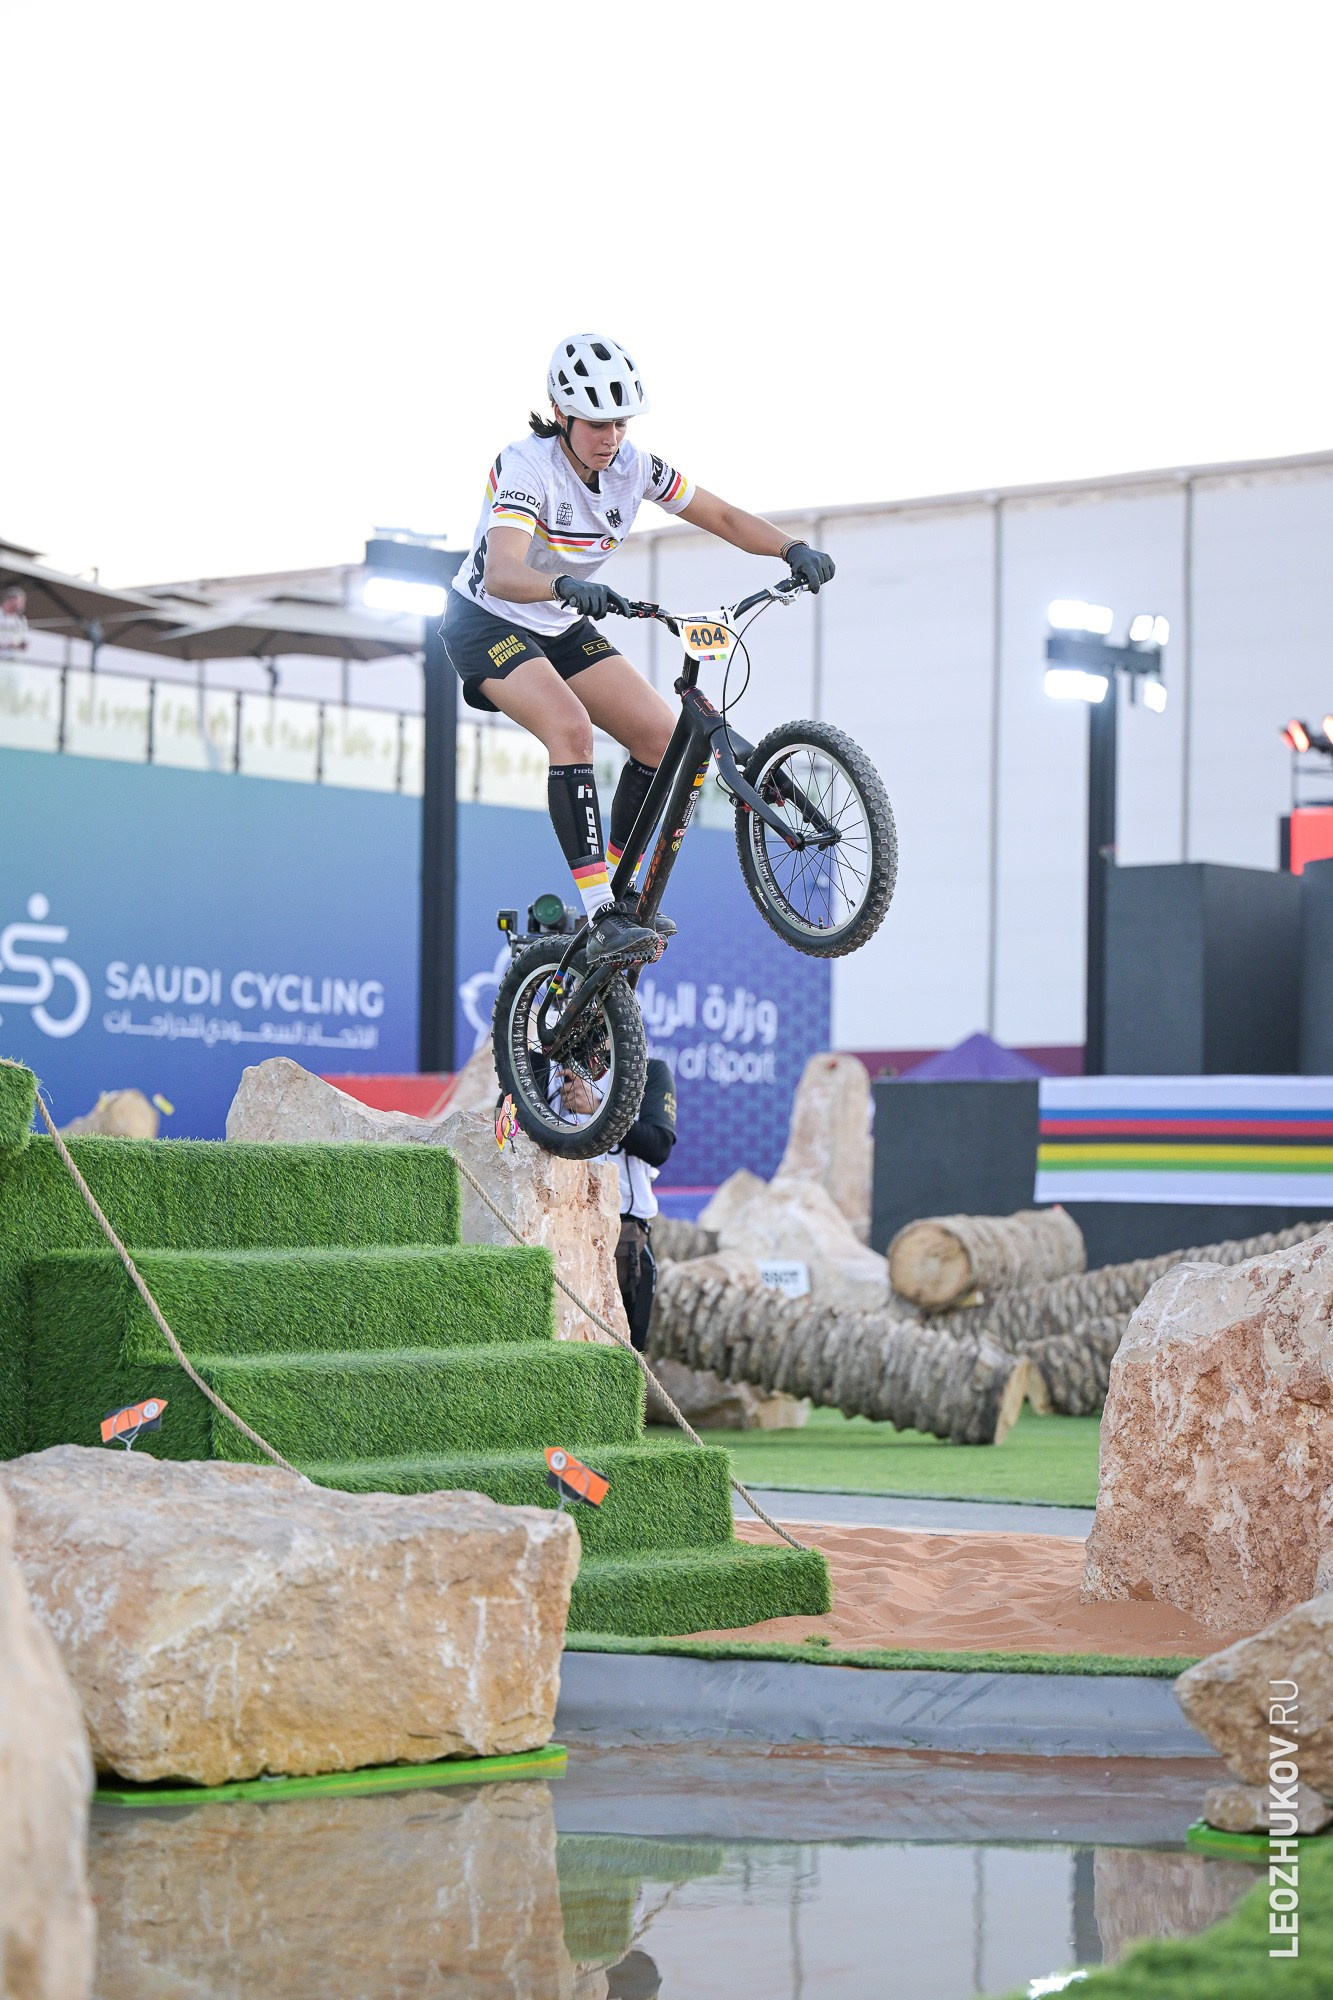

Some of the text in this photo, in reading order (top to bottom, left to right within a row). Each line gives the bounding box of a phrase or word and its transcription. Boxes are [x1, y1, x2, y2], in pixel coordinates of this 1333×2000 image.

[487, 634, 519, 659] EMILIA
[690, 627, 725, 646] 404
[493, 642, 526, 668] KEIKUS
[105, 961, 384, 1018] SAUDI CYCLING
[702, 983, 778, 1045] وزارة
[678, 1042, 708, 1081] of
[707, 1042, 777, 1087] Sport
